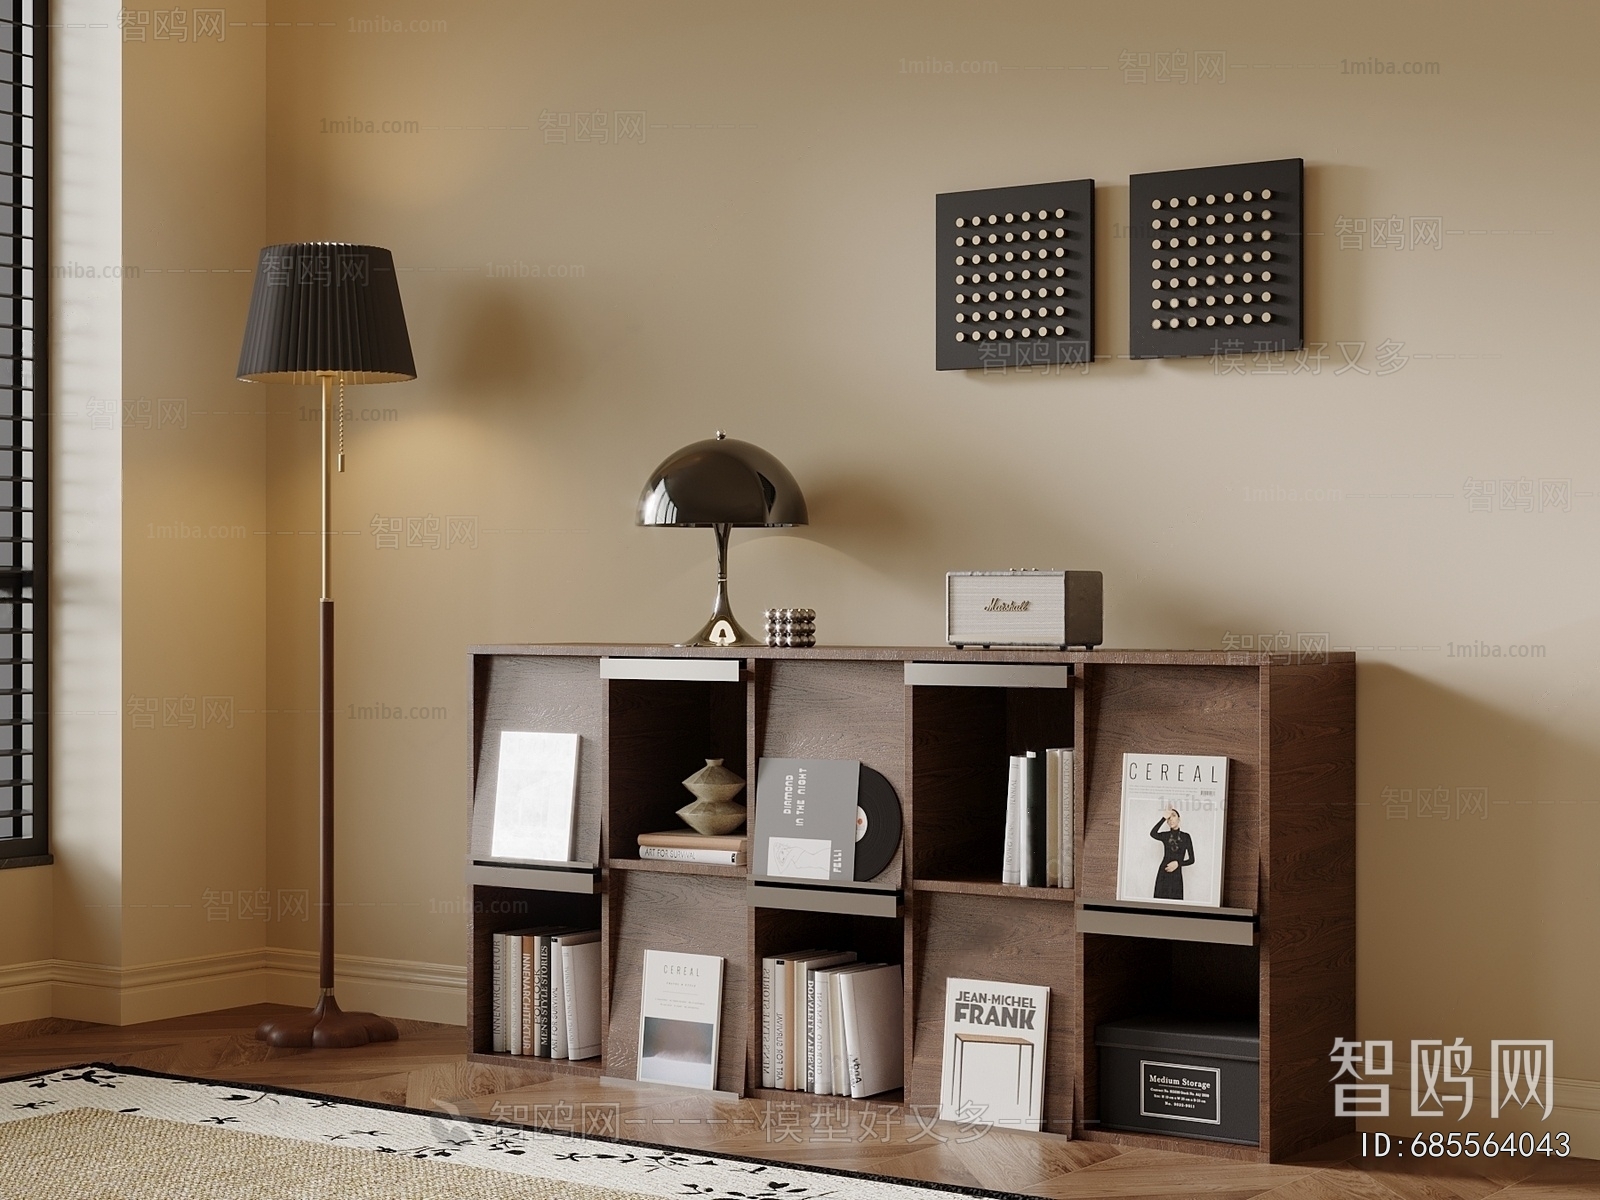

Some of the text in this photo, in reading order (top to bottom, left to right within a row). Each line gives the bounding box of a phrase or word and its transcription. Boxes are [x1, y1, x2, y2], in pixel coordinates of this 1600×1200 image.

[984, 597, 1031, 612] Marshall
[1129, 762, 1218, 783] CEREAL
[783, 774, 794, 815] DIAMOND
[795, 767, 807, 826] IN THE NIGHT
[644, 848, 695, 860] ART FOR SURVIVAL
[833, 849, 842, 873] FELLI
[540, 945, 548, 985] STORIES
[664, 964, 700, 977] CEREAL
[522, 953, 531, 1049] INNENARCHITEKTUR
[540, 986, 548, 1015] STYLE
[955, 990, 1036, 1009] JEAN-MICHEL
[954, 1002, 1036, 1030] FRANK
[1149, 1074, 1211, 1090] Medium Storage
